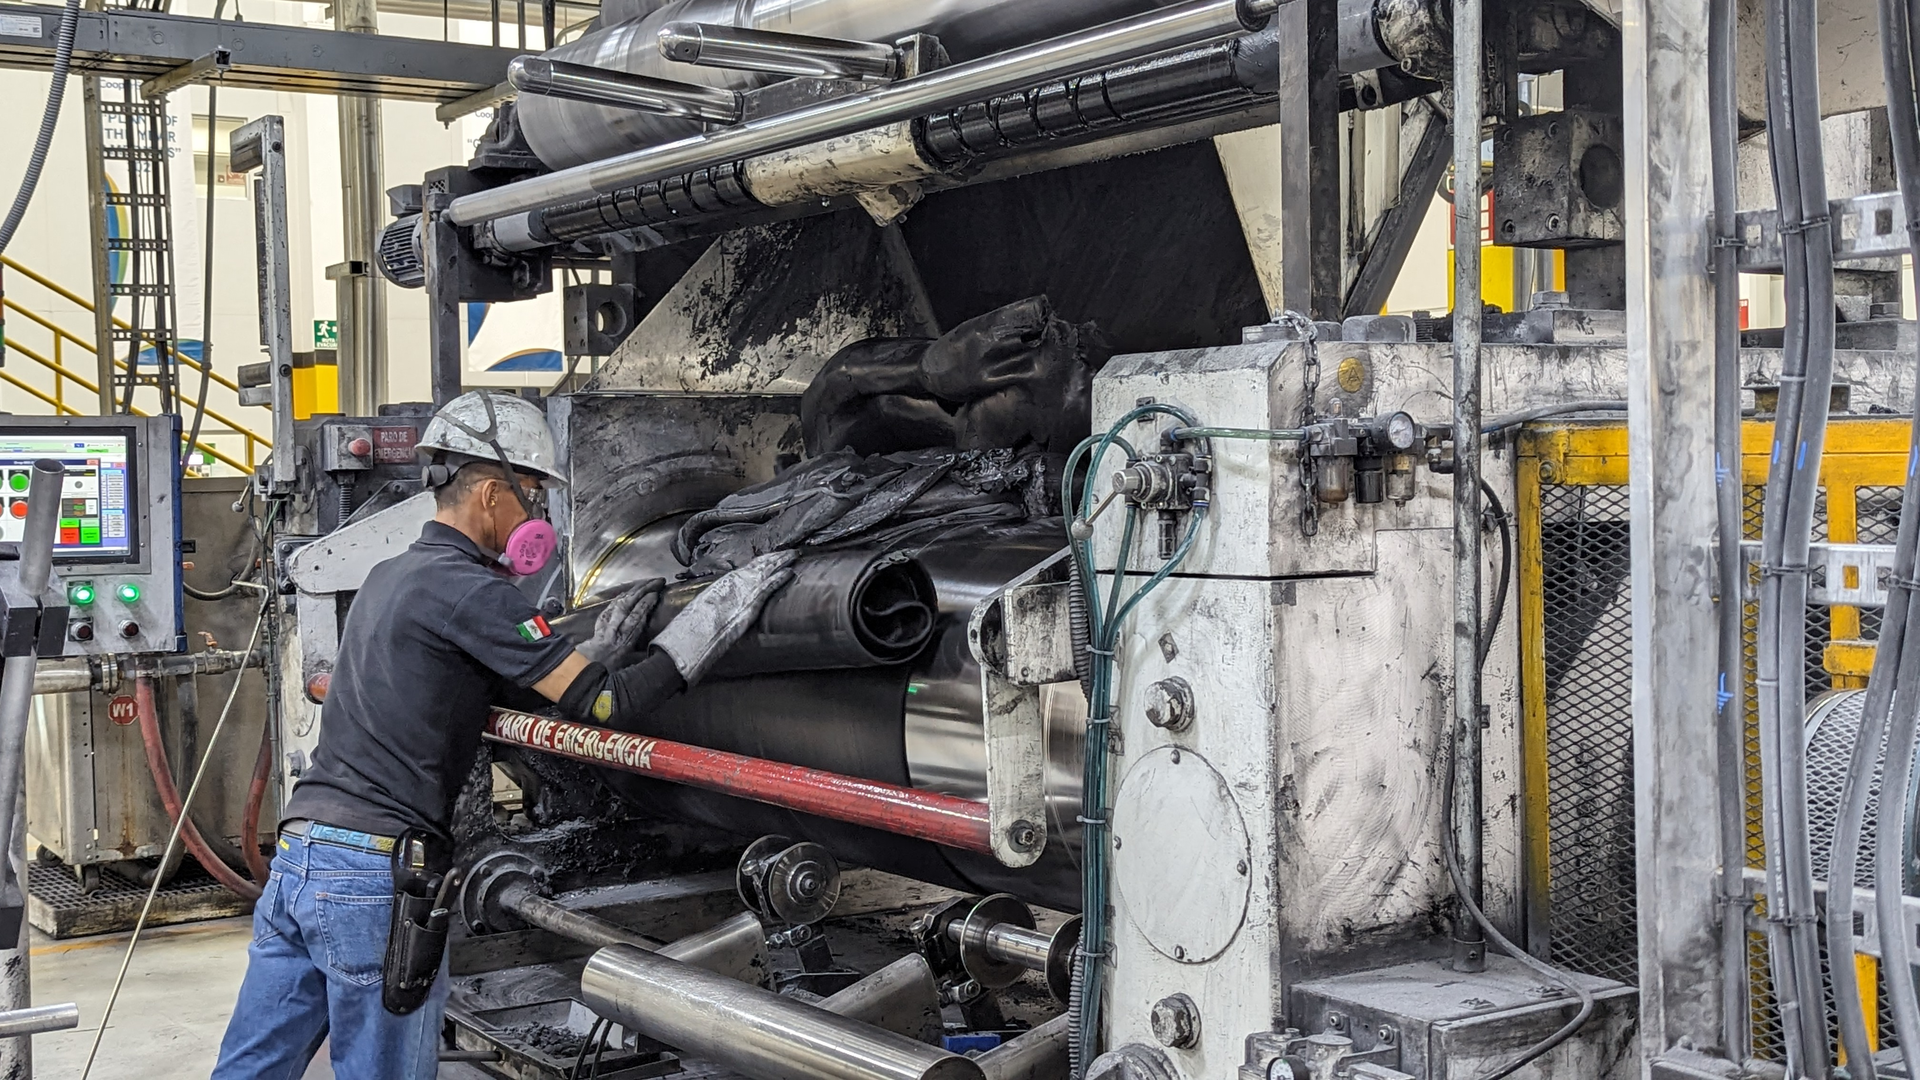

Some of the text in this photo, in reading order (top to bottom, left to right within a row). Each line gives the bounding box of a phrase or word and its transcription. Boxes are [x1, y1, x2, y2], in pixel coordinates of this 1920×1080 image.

[112, 702, 134, 718] W1
[495, 712, 657, 770] PARO DE EMERGENCIA
